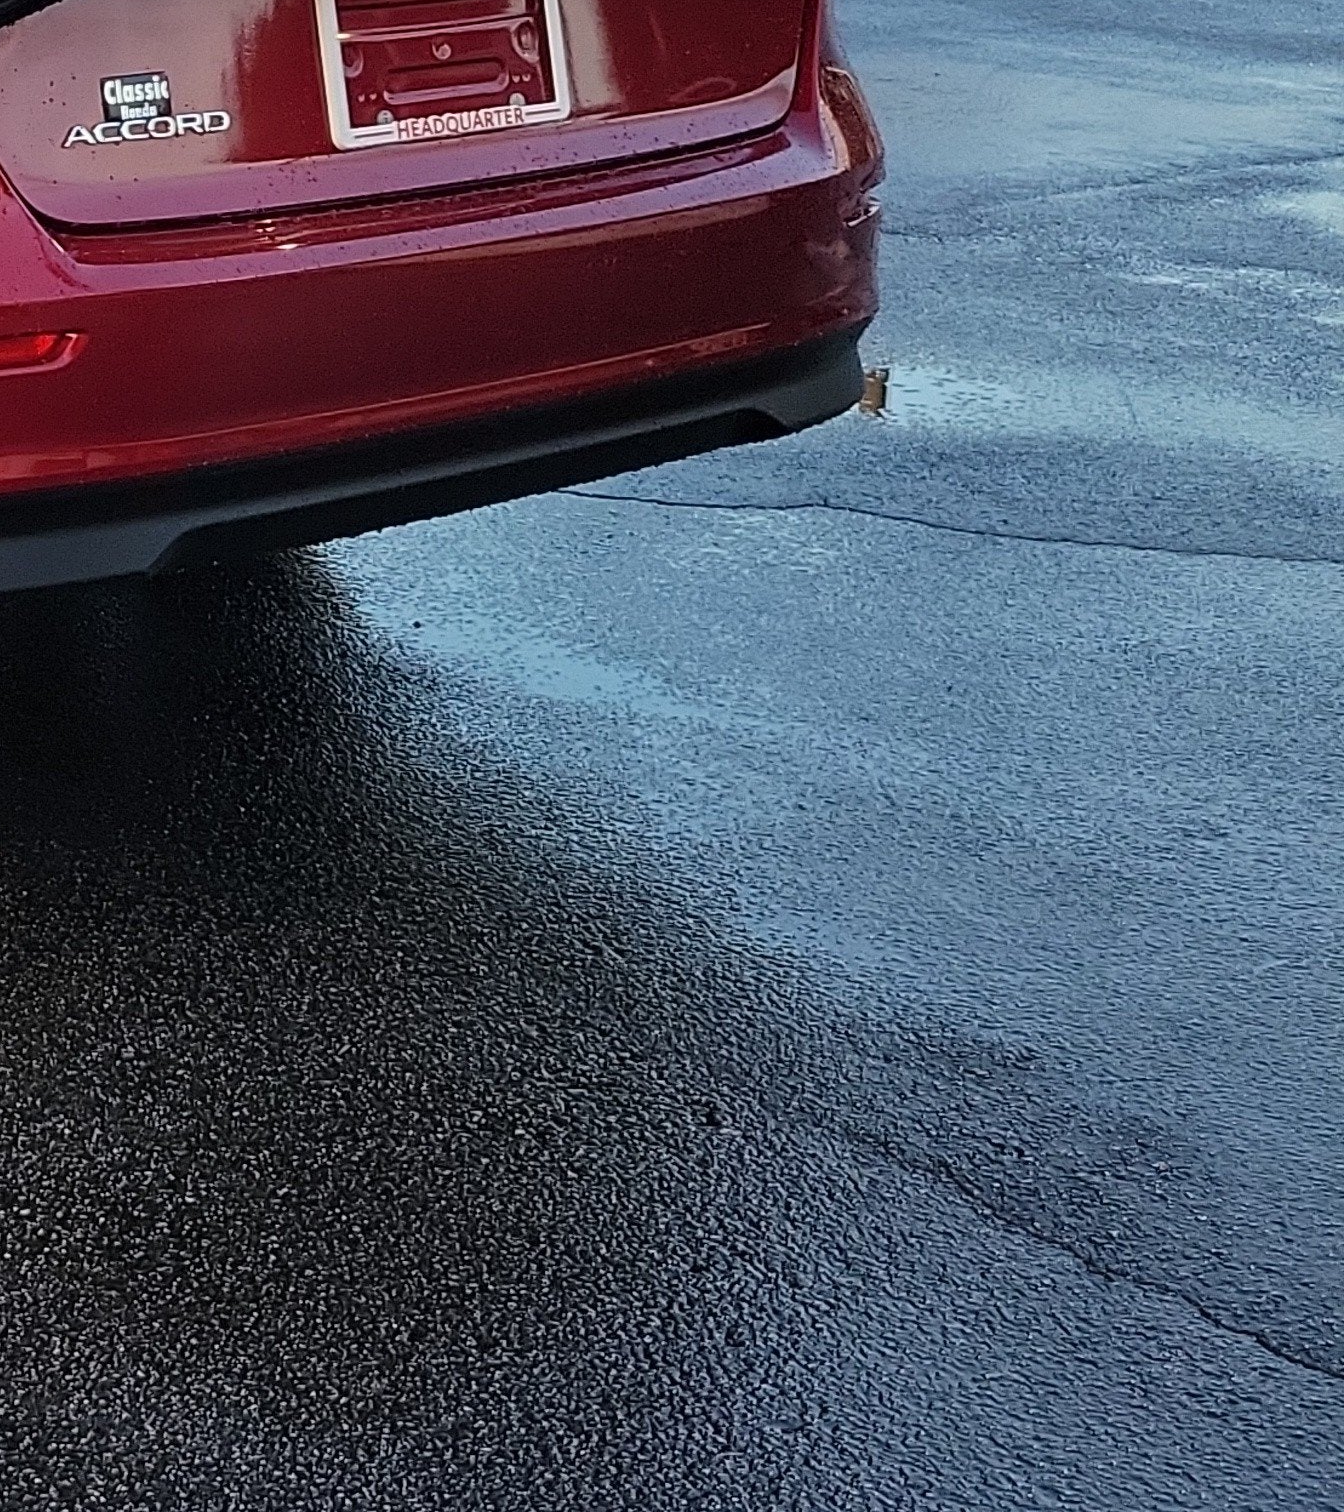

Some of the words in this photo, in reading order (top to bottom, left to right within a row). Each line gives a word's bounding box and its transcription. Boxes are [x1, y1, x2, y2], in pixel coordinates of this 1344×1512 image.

[103, 75, 170, 105] Classic
[62, 111, 231, 148] ACCORD
[396, 106, 525, 140] HEADQUARTER
